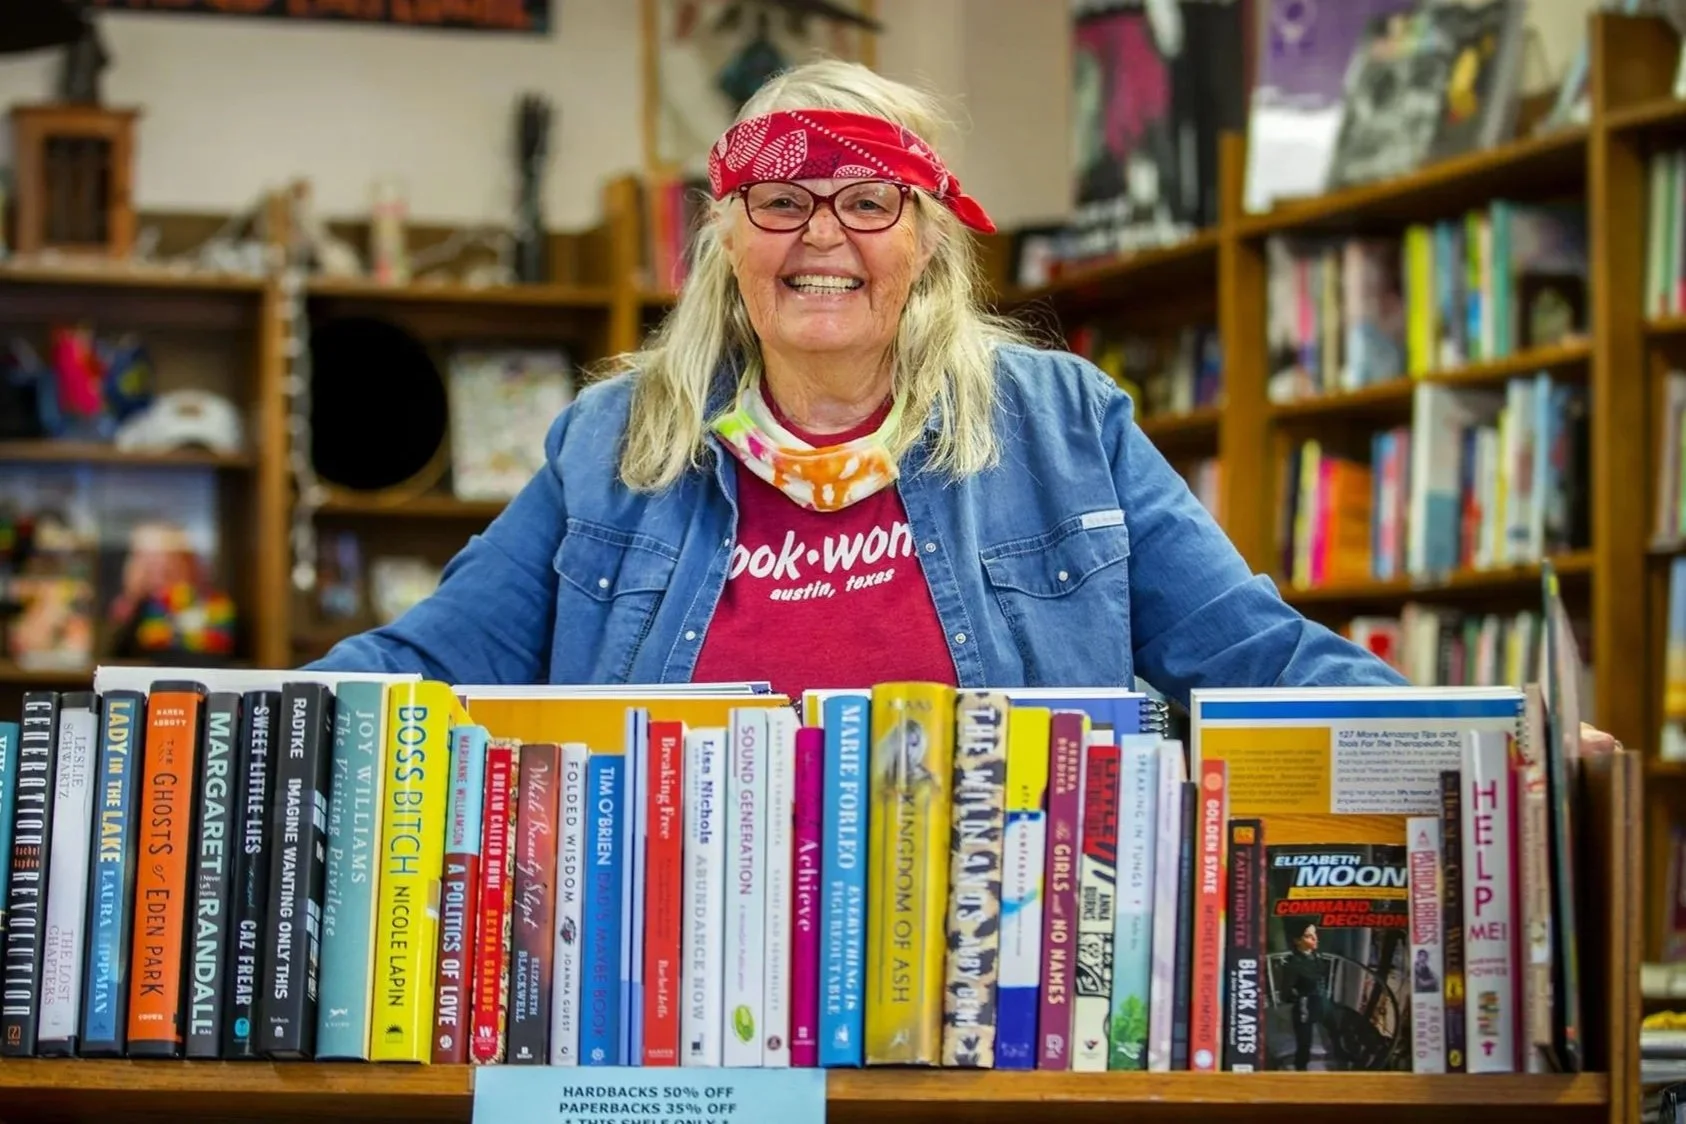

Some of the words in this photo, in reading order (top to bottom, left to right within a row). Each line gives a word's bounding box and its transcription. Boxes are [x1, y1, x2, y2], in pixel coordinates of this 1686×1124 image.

[770, 580, 836, 601] austin,
[845, 568, 895, 592] texas
[107, 702, 131, 755] LADY
[156, 708, 185, 716] KAREN
[251, 706, 270, 756] SWEET
[290, 698, 307, 759] RADTKE
[336, 712, 351, 747] The
[356, 711, 375, 755] JOY
[964, 706, 996, 755] THE
[1357, 730, 1379, 738] More
[1381, 730, 1419, 739] Amazing
[1422, 730, 1437, 739] Tips
[1439, 730, 1457, 738] and
[58, 722, 76, 800] SCHWARTZ
[72, 736, 87, 788] LESLIE
[394, 706, 428, 782] BOSS
[455, 735, 470, 784] MARIANNE
[702, 740, 714, 775] Lisa
[740, 725, 755, 785] SOUND
[839, 704, 862, 776] MARIE
[1361, 740, 1374, 748] For
[1377, 740, 1392, 748] The
[15, 701, 52, 845] GENERATION
[108, 757, 124, 774] IN
[247, 761, 267, 814] LITTLE
[526, 763, 549, 813] While
[598, 766, 615, 796] TIM
[655, 736, 677, 805] Breaking
[1134, 753, 1146, 819] SPEAKING
[106, 779, 123, 807] THE
[149, 773, 178, 855] GHOSTS
[201, 711, 232, 873] MARGARET
[284, 778, 302, 843] IMAGINE
[327, 758, 348, 838] Visiting
[452, 787, 468, 846] WILLIAMSON
[491, 773, 504, 811] DREAM
[565, 761, 579, 827] FOLDED
[700, 780, 714, 845] Nichols
[101, 811, 123, 863] LAKE
[244, 819, 263, 855] LIES
[351, 765, 372, 884] WILLIAMS
[390, 790, 423, 874] BITCH
[489, 814, 504, 856] CALLED
[516, 815, 549, 878] Beauty
[596, 798, 614, 866] O'BRIEN
[659, 806, 675, 840] Free
[738, 789, 754, 895] GENERATION
[837, 781, 860, 869] FORLEO
[1134, 824, 1143, 838] IN
[1204, 798, 1220, 852] GOLDEN
[447, 863, 466, 875] A
[564, 834, 576, 903] WISDOM
[895, 794, 913, 913] KINGDOM
[1052, 844, 1072, 892] GIRLS
[1235, 851, 1246, 891] FAITH
[1274, 854, 1361, 867] ELIZABETH
[1472, 780, 1497, 917] HELP
[99, 870, 116, 928] LAURA
[280, 846, 297, 918] WANTING
[323, 847, 344, 937] Privilege
[486, 860, 501, 890] HOME
[797, 838, 819, 932] Achieve
[1203, 854, 1218, 895] STATE
[1296, 865, 1407, 887] MOON
[1411, 850, 1438, 900] PATRICIA
[145, 888, 170, 937] EDEN
[390, 885, 410, 949] NICOLE
[443, 881, 465, 953] POLITICS
[485, 908, 498, 953] REYNA
[514, 881, 545, 930] Slept
[693, 854, 708, 971] ABUNDANCE
[1234, 894, 1246, 947] HUNTER
[1276, 900, 1371, 915] COMMAND
[1321, 914, 1407, 927] DECISION
[1412, 902, 1438, 946] BRIGGS
[3, 871, 40, 1016] REVOLUTION
[60, 929, 74, 961] THE
[239, 919, 257, 950] CAZ
[277, 921, 292, 962] ONLY
[593, 926, 608, 983] MAYBE
[845, 885, 861, 989] EVERYTHING
[893, 920, 912, 950] OF
[1050, 919, 1068, 944] NO
[1468, 922, 1507, 941] ME!
[44, 924, 60, 1006] CHAPTERS
[57, 962, 71, 1003] LOST
[94, 931, 112, 1014] LIPPMAN
[139, 945, 165, 997] PARK
[190, 898, 220, 1036] RANDALL
[235, 955, 255, 1005] FREAR
[274, 963, 290, 1000] THIS
[388, 955, 407, 1007] LAPIN
[441, 958, 460, 980] OF
[482, 959, 496, 1013] GRANDE
[515, 950, 528, 1023] BLACKWELL
[529, 957, 540, 1016] ELIZABETH
[562, 953, 571, 995] JOANNA
[891, 957, 911, 1003] ASH
[1048, 948, 1066, 1005] NAMES
[1237, 959, 1257, 1010] BLACK
[438, 985, 459, 1027] LOVE
[561, 999, 570, 1032] GUEST
[592, 988, 607, 1038] BOOK
[692, 977, 706, 1020] NOW
[1199, 973, 1213, 1042] RICHMOND
[1237, 1013, 1257, 1054] ARTS
[1415, 1002, 1428, 1059] BURNED
[1429, 1005, 1441, 1052] FROST
[559, 1102, 661, 1114] PAPERBACKS
[665, 1102, 702, 1114] 35%
[707, 1102, 737, 1114] OFF
[563, 1086, 658, 1098] HARDBACKS
[663, 1086, 699, 1098] 50%
[704, 1087, 734, 1098] OFF
